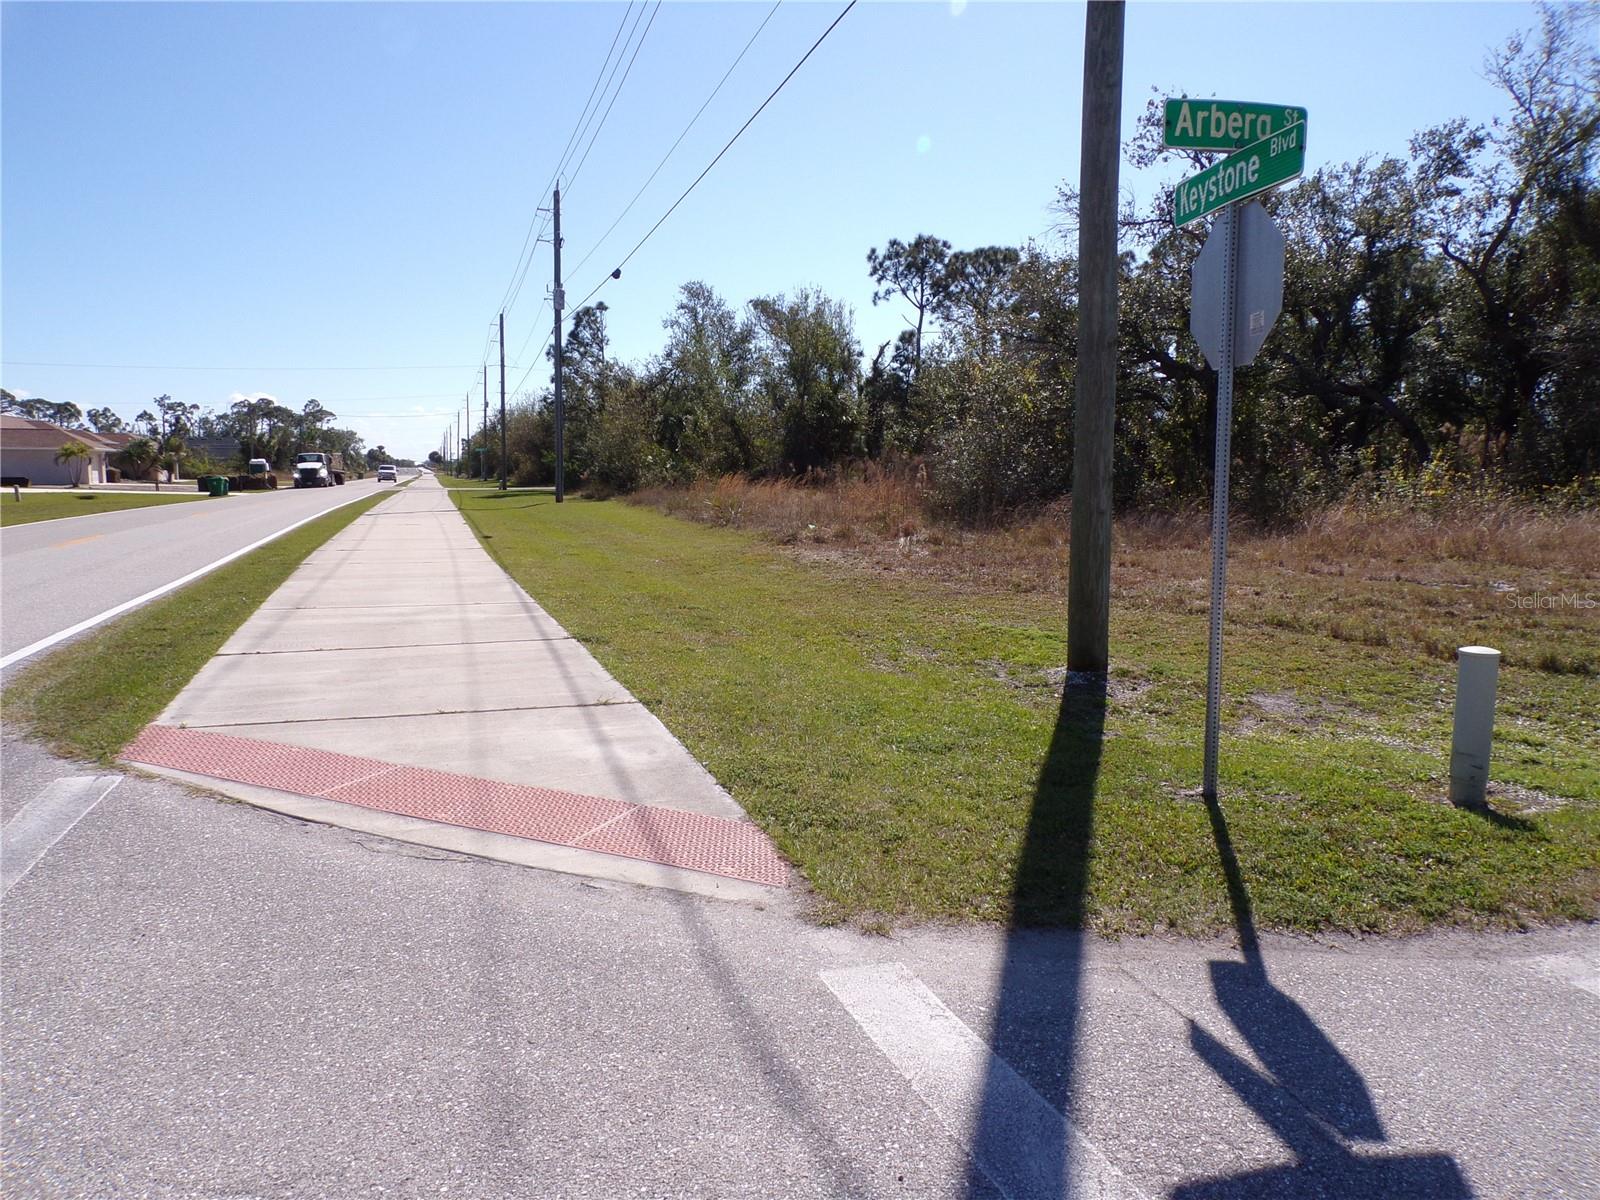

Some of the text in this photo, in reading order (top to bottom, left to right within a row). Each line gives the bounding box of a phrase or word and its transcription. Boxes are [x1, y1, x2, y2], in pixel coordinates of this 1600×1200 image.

[1283, 108, 1299, 127] St
[1179, 129, 1297, 217] Keystone Blvd
